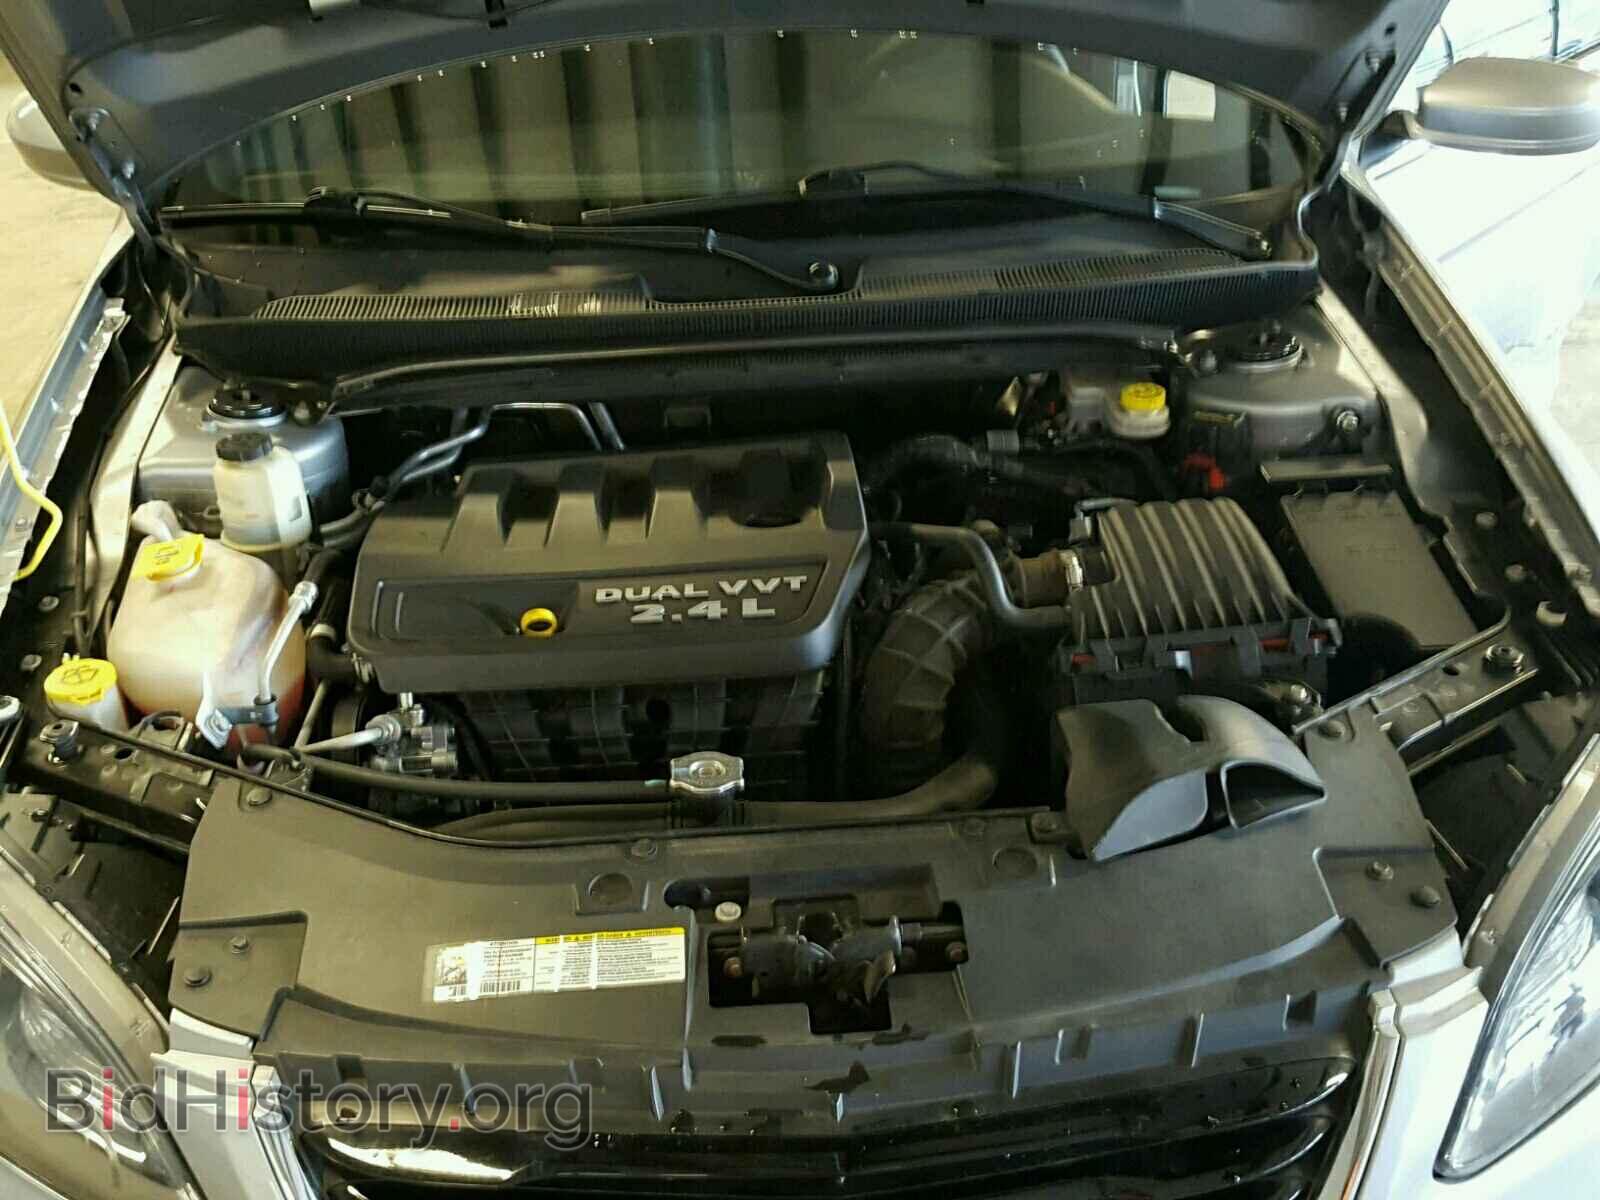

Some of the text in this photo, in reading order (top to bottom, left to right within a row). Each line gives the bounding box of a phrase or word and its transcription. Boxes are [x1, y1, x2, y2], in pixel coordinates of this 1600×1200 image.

[596, 576, 807, 603] DUAL VVT
[630, 598, 776, 625] 2.4 L
